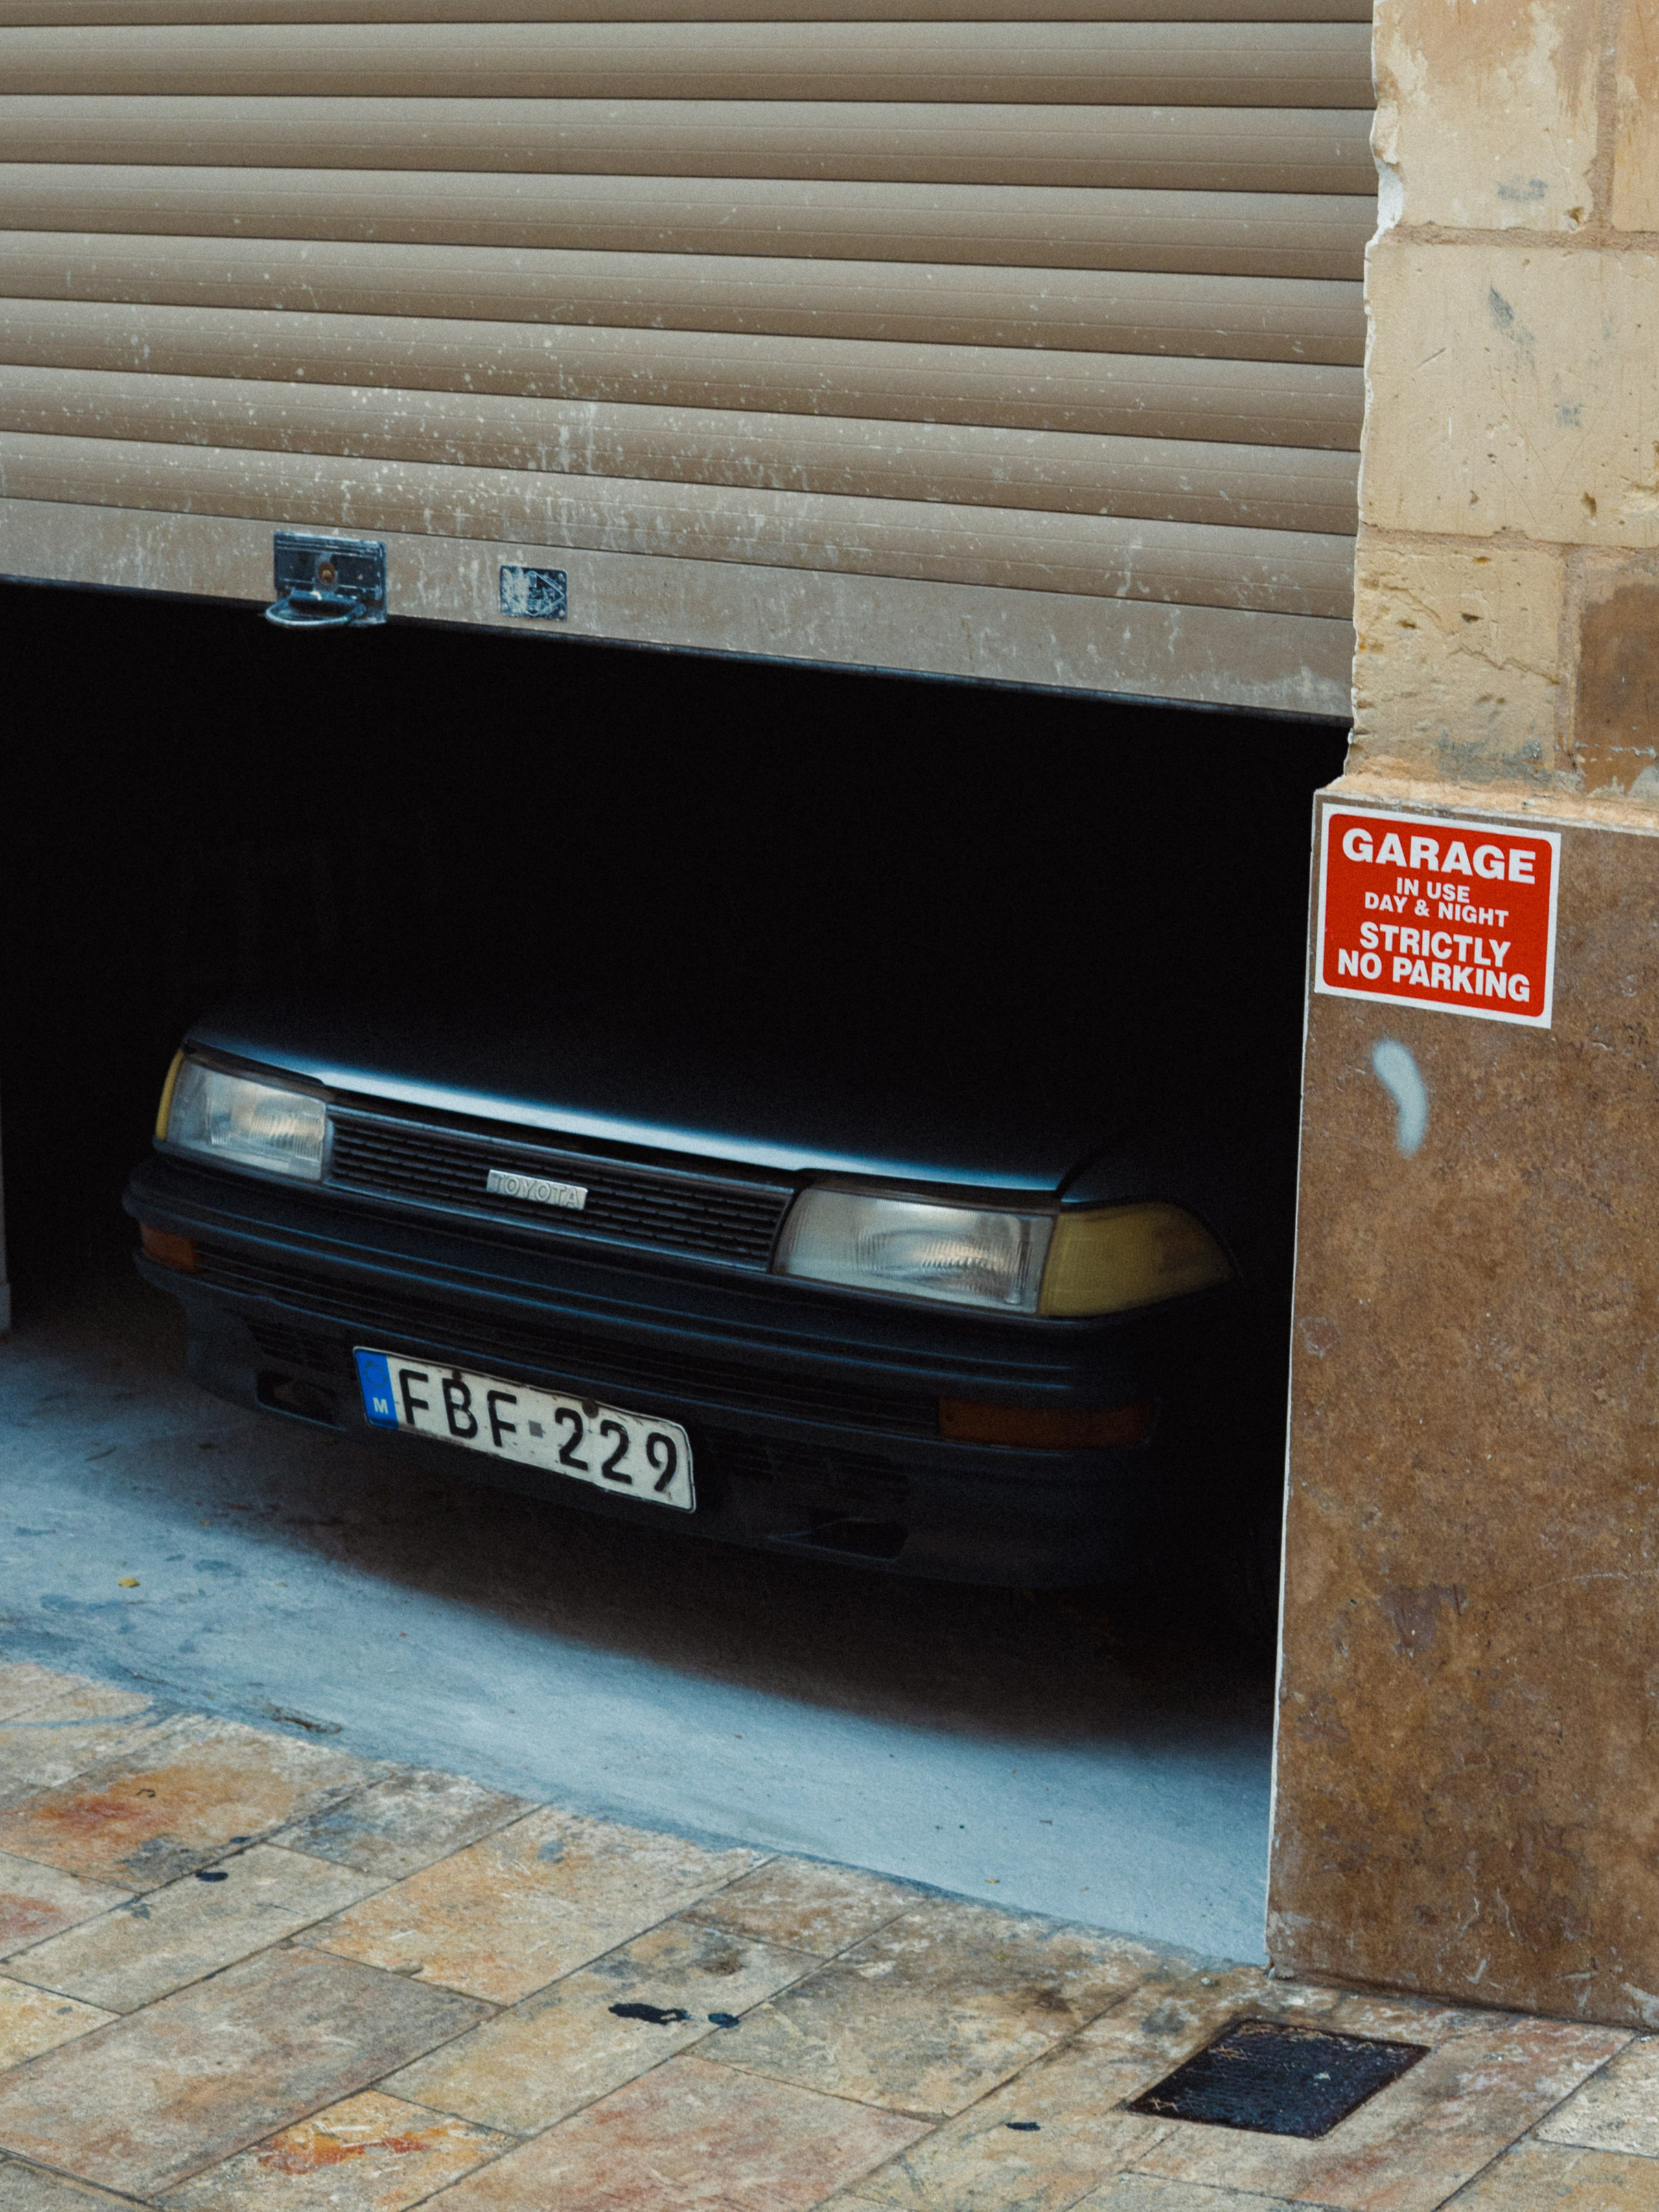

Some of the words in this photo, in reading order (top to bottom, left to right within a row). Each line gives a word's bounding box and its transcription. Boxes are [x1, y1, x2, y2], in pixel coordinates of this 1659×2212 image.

[1342, 828, 1536, 884] GARAGE
[1397, 877, 1419, 896] IN
[1426, 881, 1470, 903] USE
[1364, 892, 1408, 914] DAY
[1414, 899, 1430, 917] &
[1438, 902, 1509, 927] NIGHT
[1359, 921, 1511, 967] STRICTLY
[1338, 948, 1382, 980] NO
[1392, 956, 1531, 1003] PARKING
[491, 1173, 580, 1208] TOYOTA
[373, 1397, 388, 1414] M
